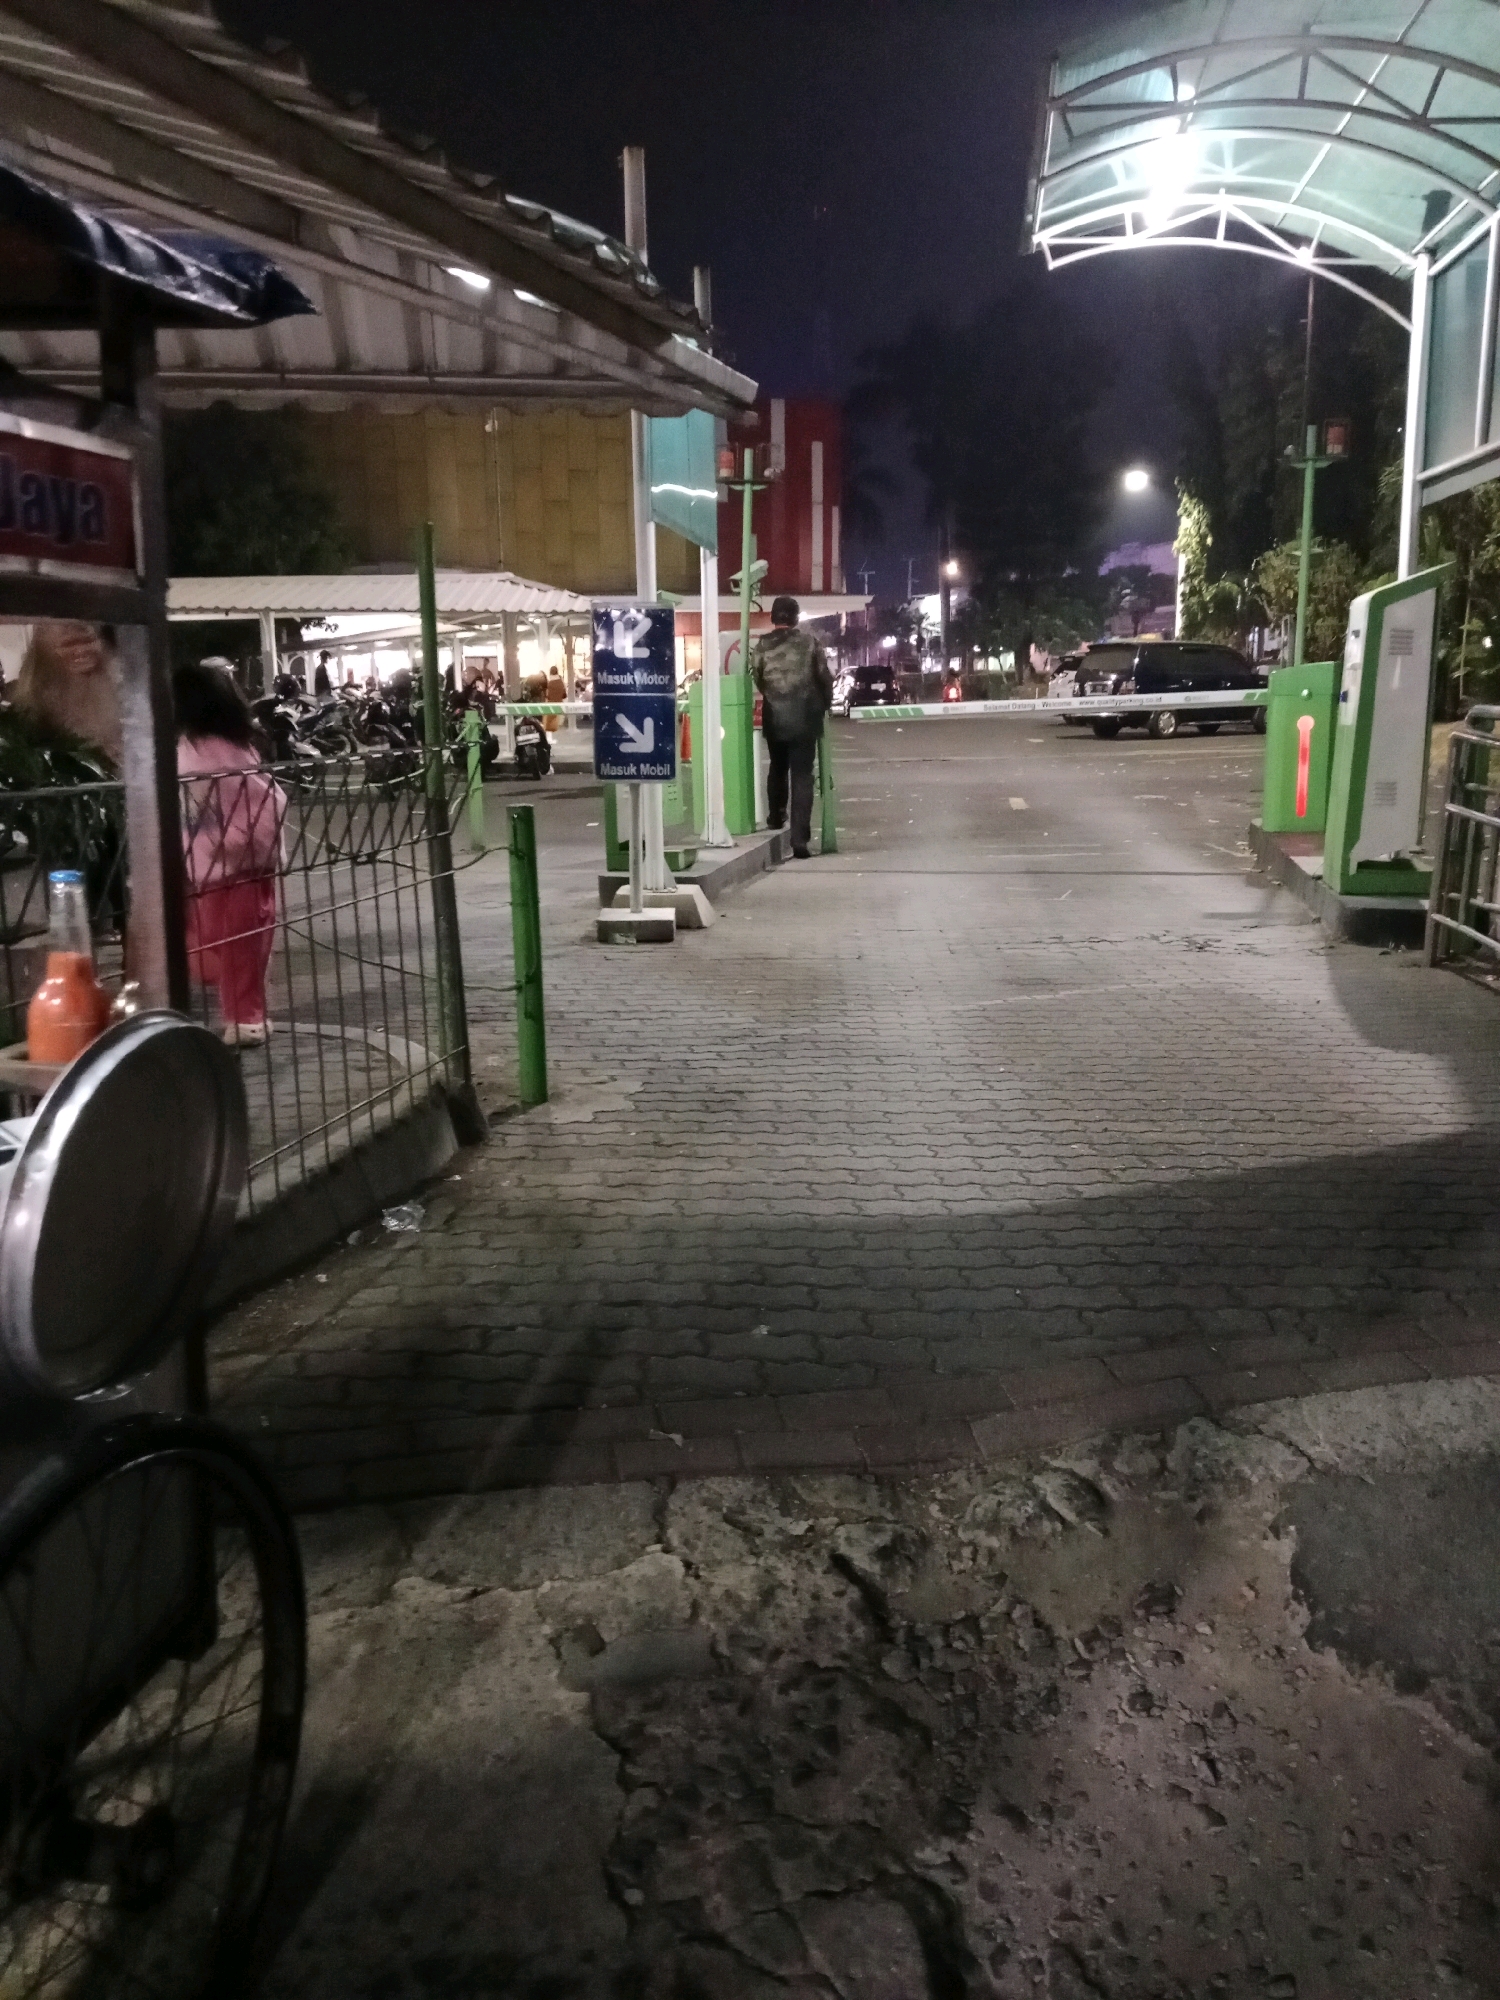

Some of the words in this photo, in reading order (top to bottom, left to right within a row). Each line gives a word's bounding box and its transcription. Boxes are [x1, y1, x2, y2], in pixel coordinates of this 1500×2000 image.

[597, 672, 634, 685] Masuk
[637, 672, 670, 685] Motor
[1042, 700, 1071, 708] Welcome
[600, 763, 637, 776] Masuk
[640, 763, 670, 776] Mobil
